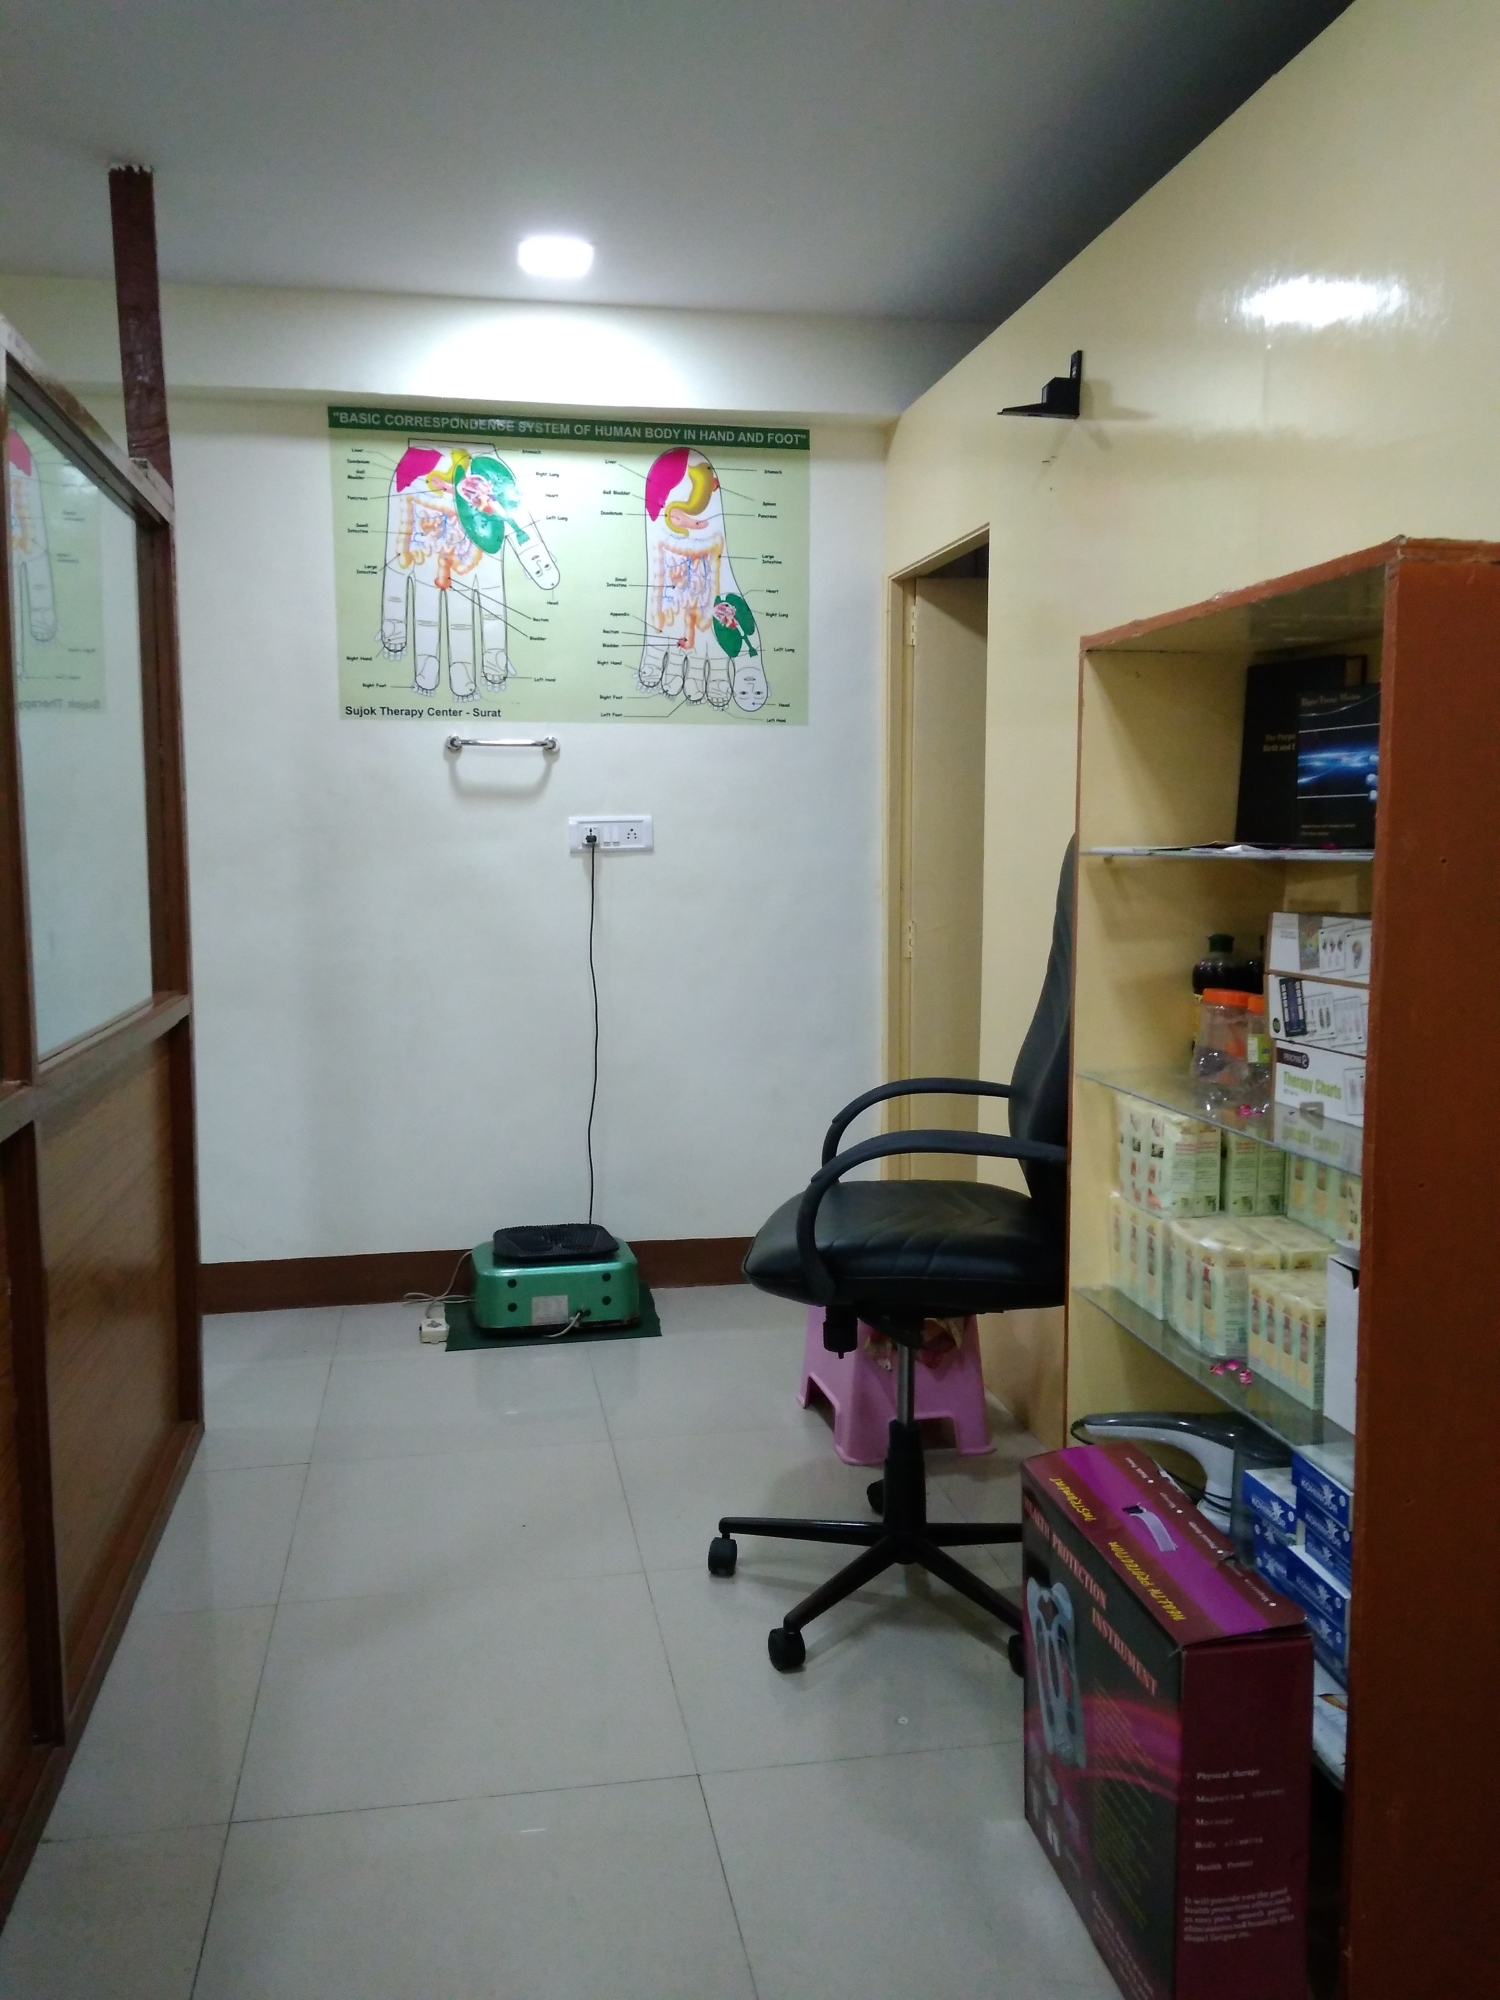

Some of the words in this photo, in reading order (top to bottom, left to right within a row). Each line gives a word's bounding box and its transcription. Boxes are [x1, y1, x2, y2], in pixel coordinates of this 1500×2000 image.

[384, 414, 515, 433] CORRESPONDENCE
[518, 420, 570, 434] SYSTEM
[573, 424, 591, 436] OF
[595, 425, 641, 438] HUMAN
[645, 427, 681, 440] BODY
[684, 429, 696, 440] IN
[699, 430, 735, 442] HAND
[738, 432, 764, 443] AND
[345, 706, 377, 717] Sujok
[380, 706, 424, 718] Therapy
[427, 707, 464, 717] Center
[472, 708, 502, 718] Surat
[1049, 1477, 1097, 1522] INSTRUMENT
[1108, 1541, 1151, 1590] PROTECTION
[1051, 1532, 1108, 1611] PROTECTION
[1092, 1606, 1158, 1696] INSTRUMENT
[1151, 1587, 1186, 1622] HEALTH
[1196, 1770, 1230, 1781] Physical
[1232, 1768, 1260, 1778] therapy
